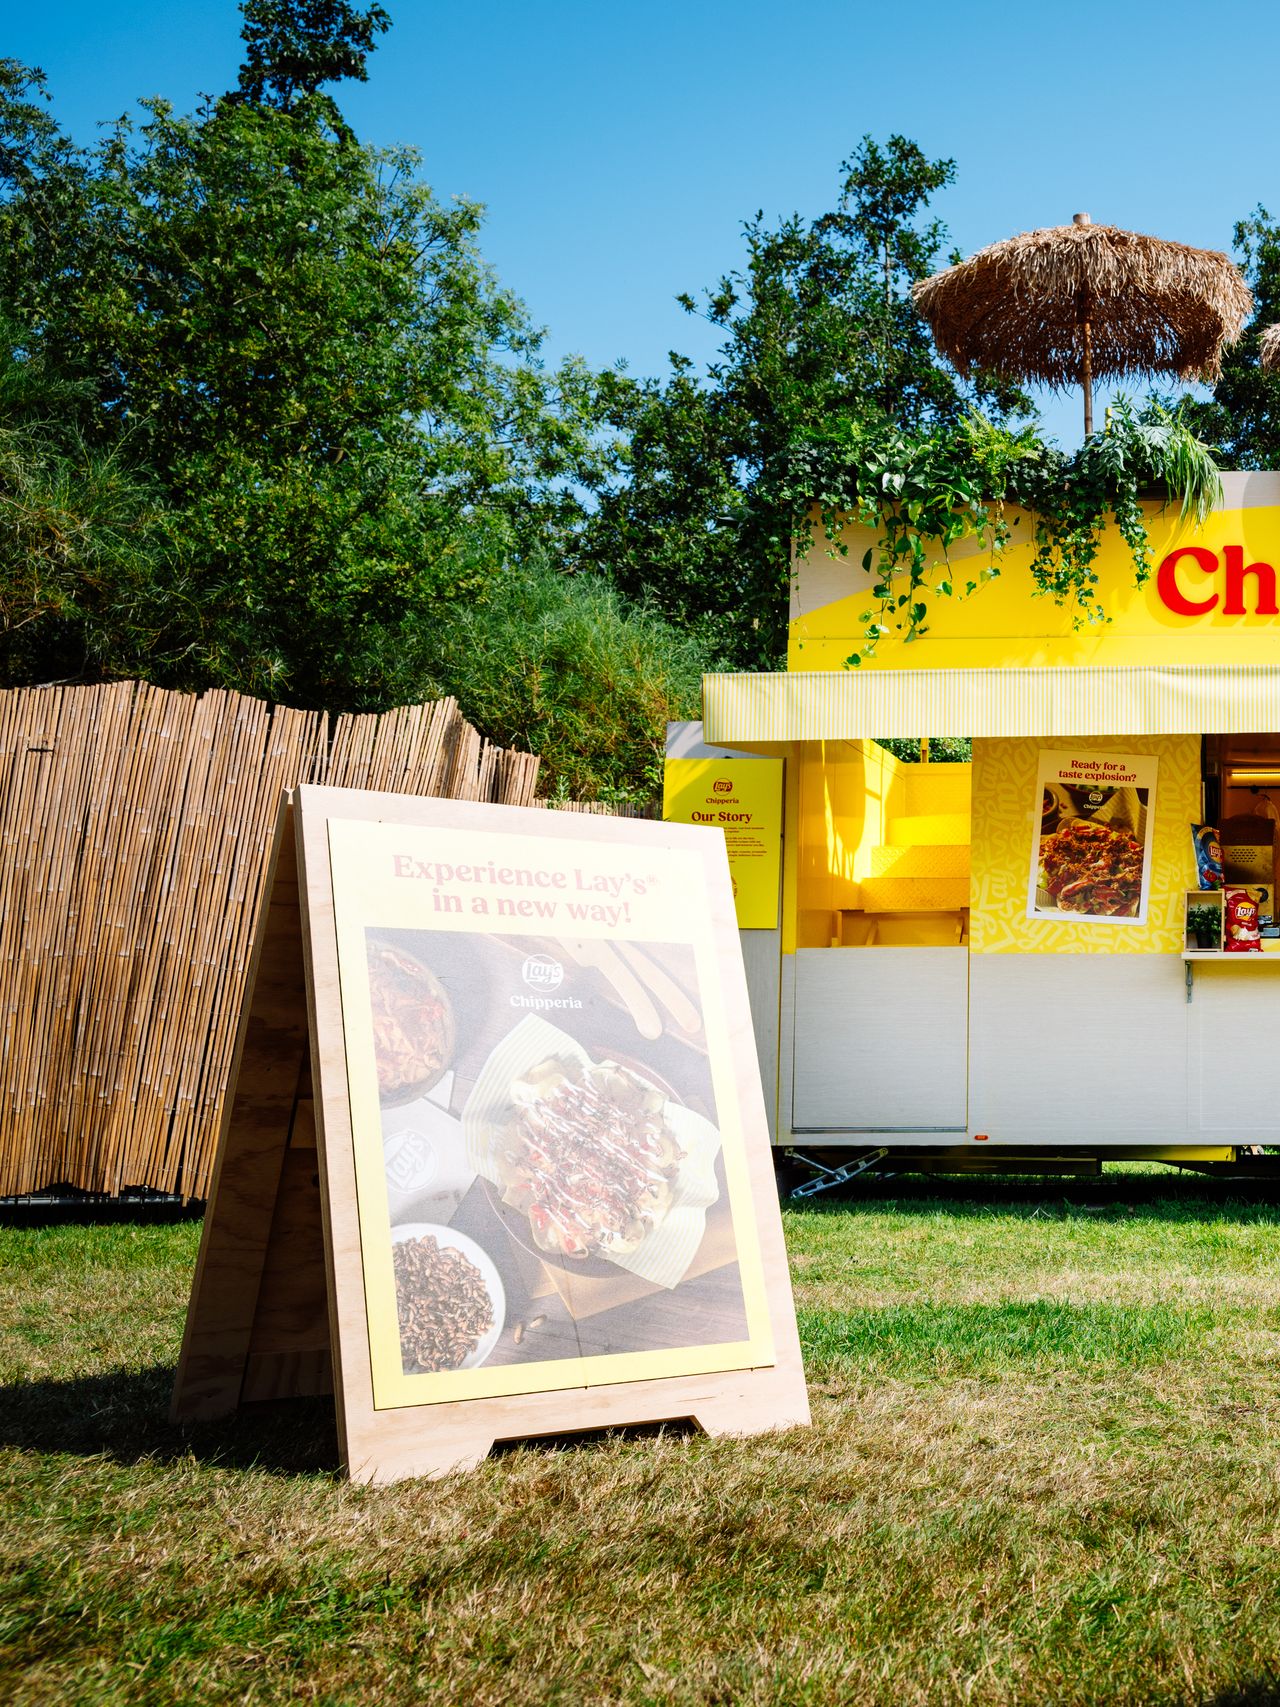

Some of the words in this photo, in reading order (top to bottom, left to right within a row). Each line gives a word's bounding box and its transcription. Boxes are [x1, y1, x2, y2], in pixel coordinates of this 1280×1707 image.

[1071, 760, 1101, 771] Ready
[1103, 762, 1118, 771] for
[1058, 770, 1082, 778] taste
[1084, 772, 1137, 781] explosion?
[691, 812, 715, 821] Our
[718, 811, 752, 824] Story
[392, 854, 567, 888] Experience
[432, 888, 463, 912] in
[472, 897, 489, 915] a
[496, 898, 557, 919] new
[567, 902, 632, 927] way!
[510, 995, 583, 1010] Chipperia
